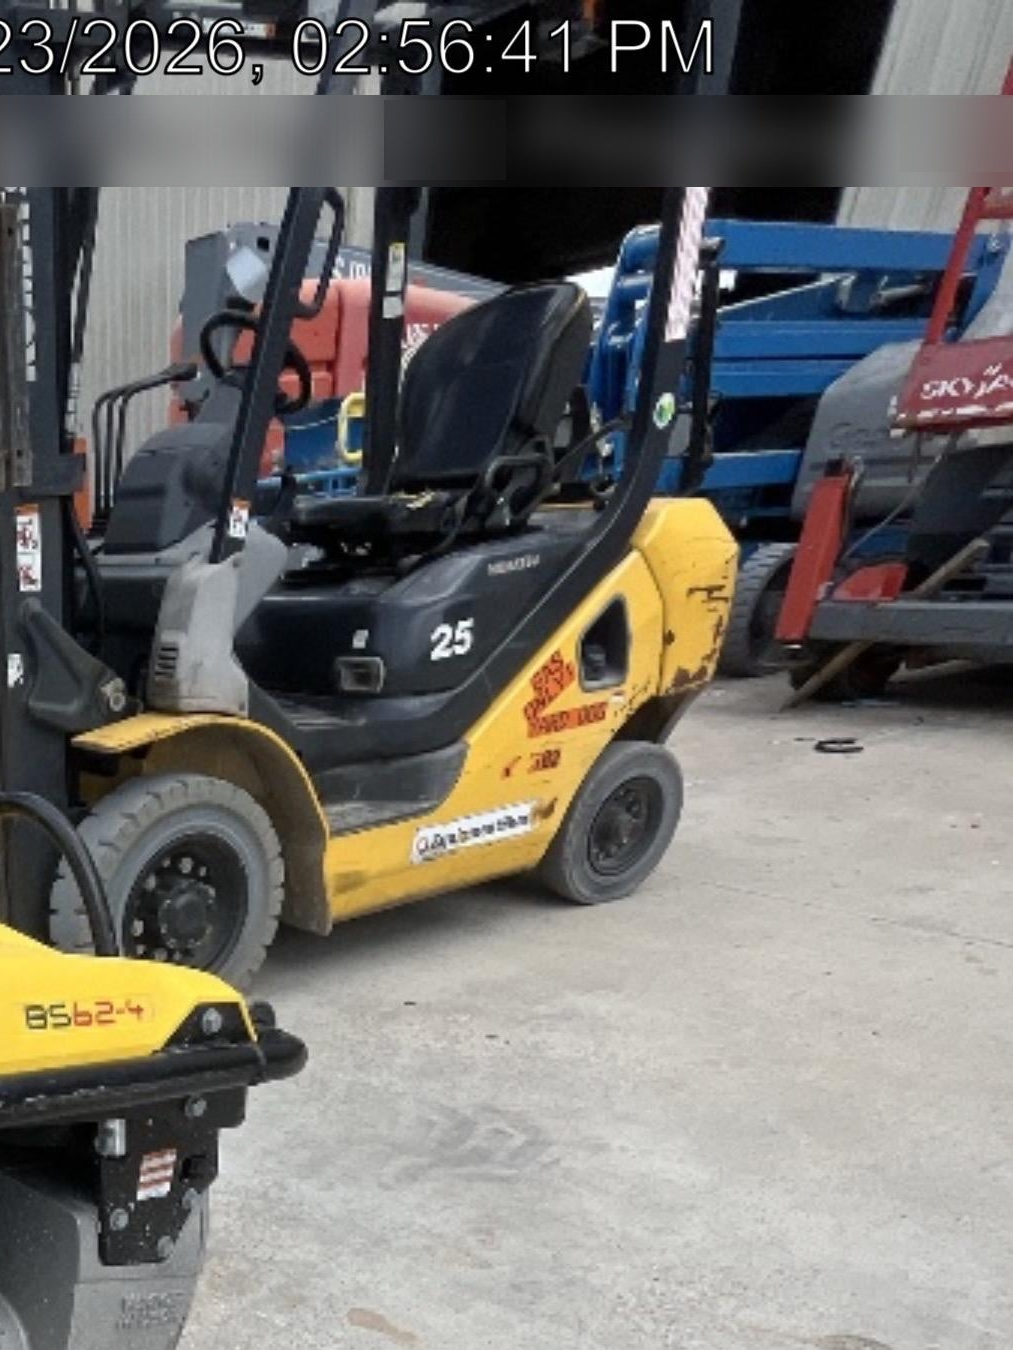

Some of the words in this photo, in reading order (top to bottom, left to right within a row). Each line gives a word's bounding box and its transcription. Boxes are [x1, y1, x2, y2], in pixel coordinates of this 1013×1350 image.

[920, 365, 1013, 400] SKYJA
[430, 618, 474, 661] 25
[25, 1000, 144, 1030] BS62-4
